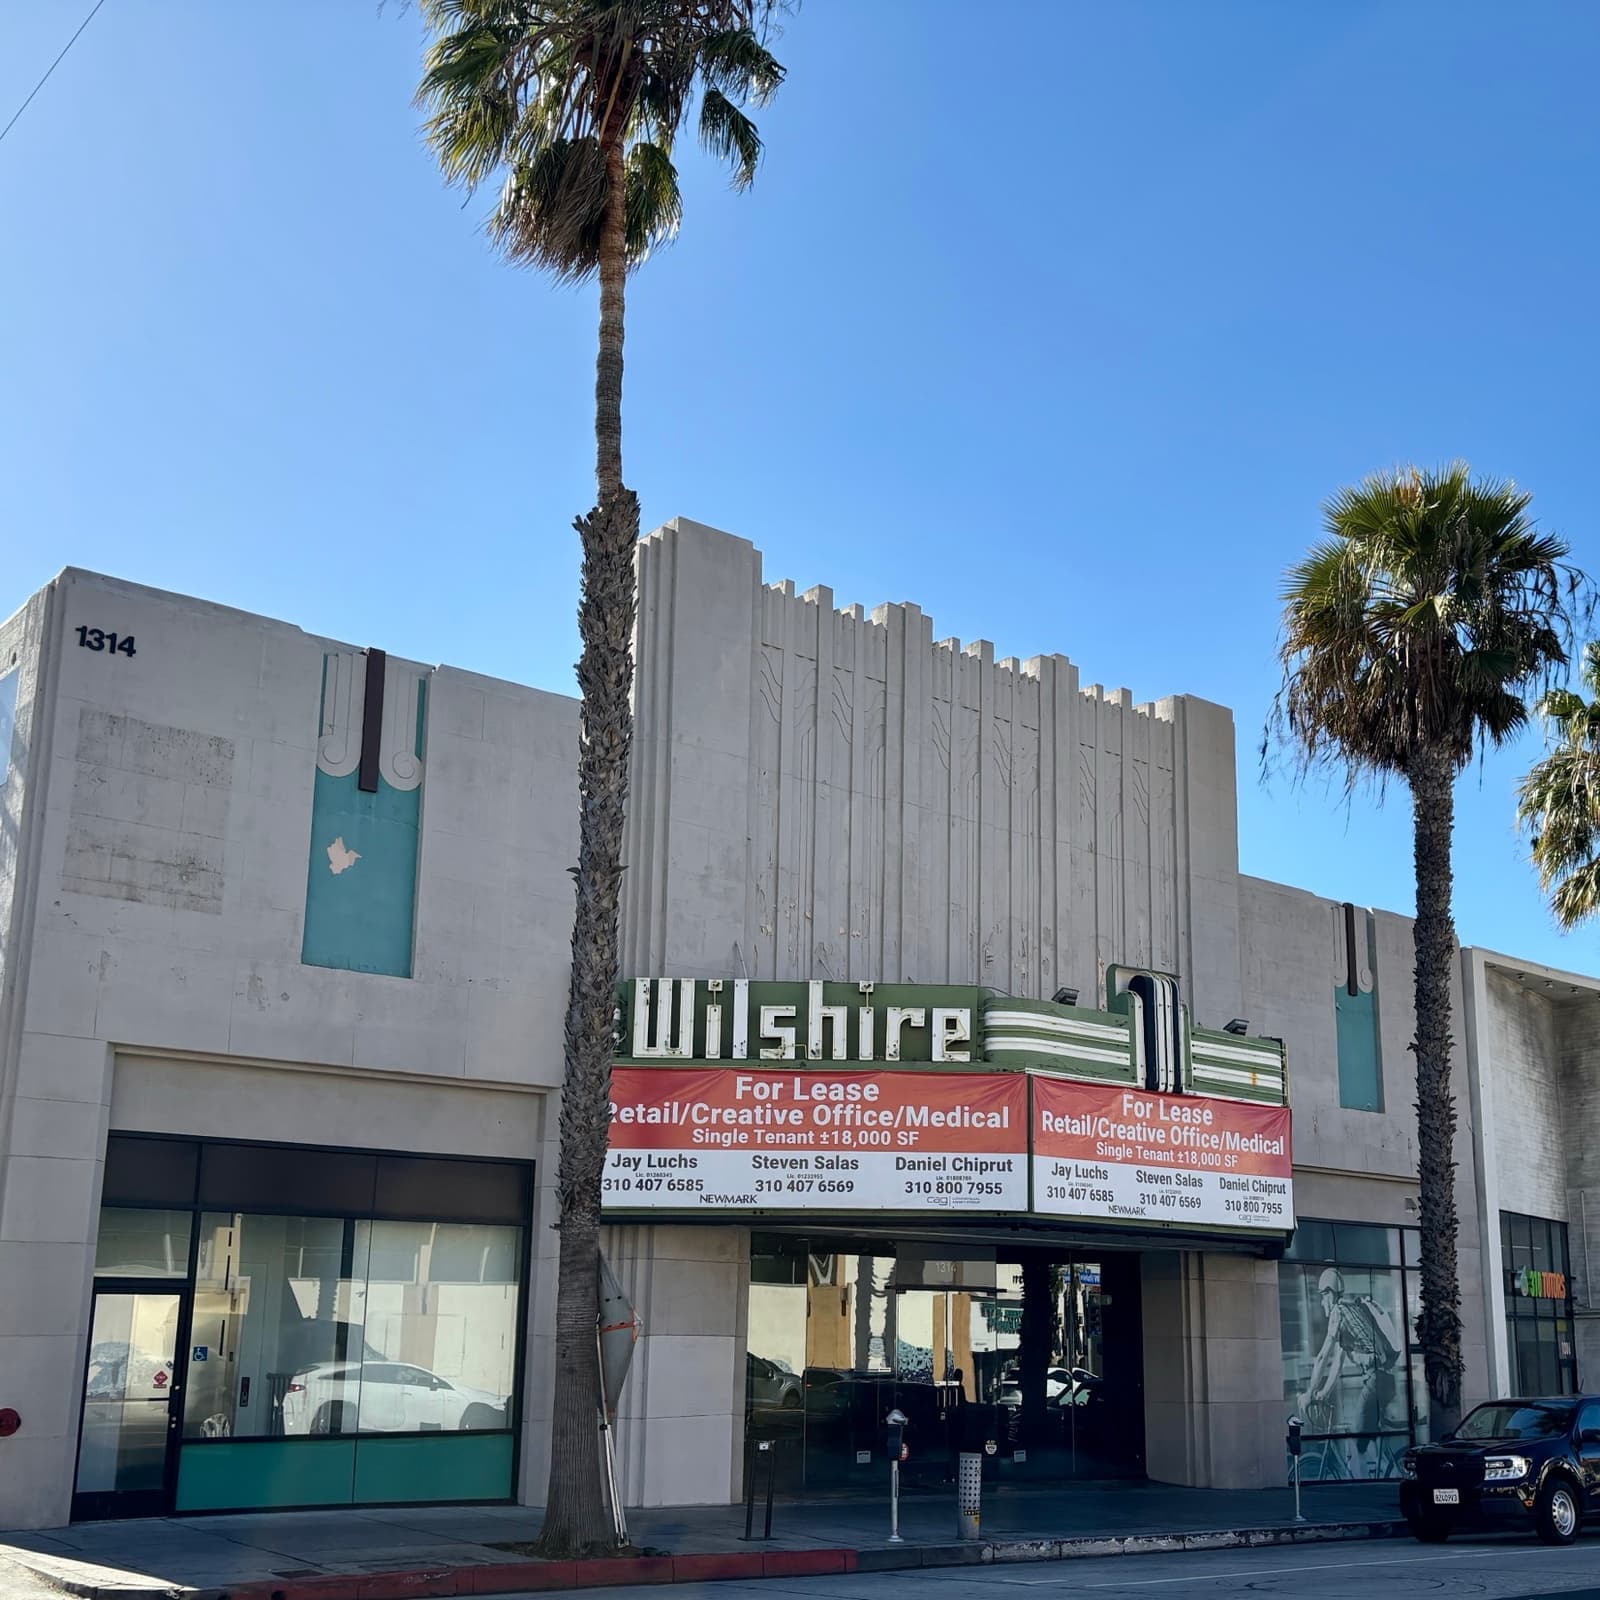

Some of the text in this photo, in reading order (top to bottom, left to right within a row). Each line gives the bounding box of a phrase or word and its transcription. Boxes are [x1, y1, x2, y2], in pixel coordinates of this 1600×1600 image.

[75, 625, 136, 658] 1314
[632, 978, 971, 1062] Wilshire
[735, 1076, 880, 1102] For Lease
[812, 1103, 1009, 1128] Office/Medical
[1122, 1094, 1213, 1126] For Lease
[692, 1128, 919, 1148] Single Tenant ±18,000 SF
[1042, 1110, 1284, 1156] Retail/Creative Office/Medical
[611, 1153, 698, 1171] Jay Luchs
[752, 1155, 859, 1170] Steven Salas
[1096, 1141, 1238, 1168] Single Tenant ±18,000 SF
[895, 1156, 1013, 1175] Daniel Chiprut
[1051, 1162, 1109, 1180] Jay Luchs
[602, 1178, 704, 1192] 310 407 6585
[755, 1180, 854, 1193] 310 407 6569
[905, 1181, 1003, 1195] 310 800 7955
[1135, 1170, 1203, 1188] Steven Salas
[1219, 1177, 1286, 1196] Daniel Chiprut
[699, 1193, 758, 1204] NEWMARK
[1047, 1186, 1114, 1202] 310 407 6585
[1139, 1193, 1201, 1209] 310 407 6569
[1108, 1204, 1146, 1216] NEWMARK
[1225, 1199, 1283, 1214] 310 800 7955
